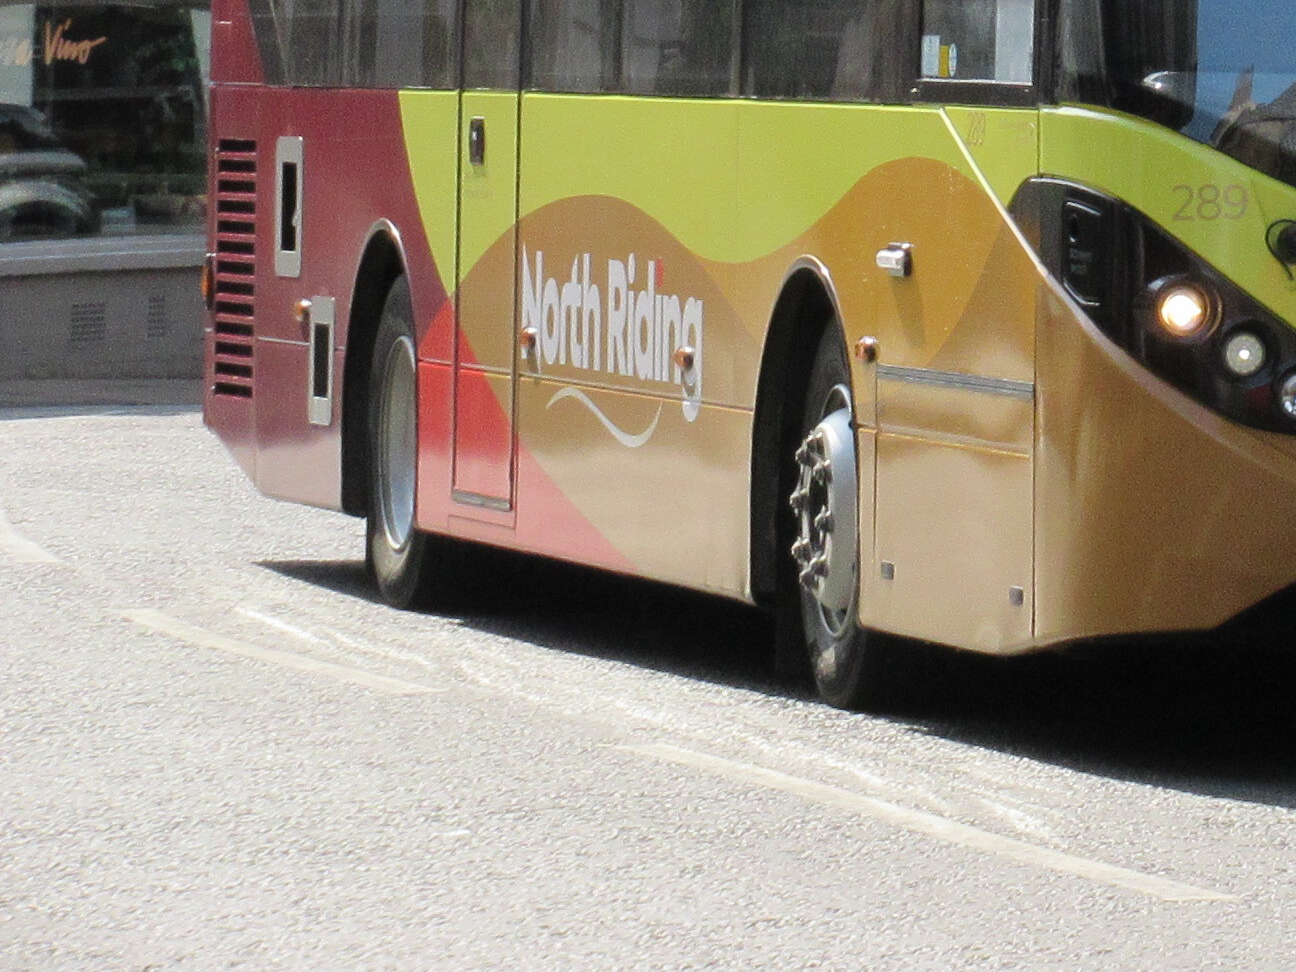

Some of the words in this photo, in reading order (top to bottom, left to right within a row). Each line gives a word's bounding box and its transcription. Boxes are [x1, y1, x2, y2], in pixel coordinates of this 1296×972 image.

[1171, 183, 1249, 221] 289
[521, 241, 601, 374] North
[607, 252, 704, 422] Riding
